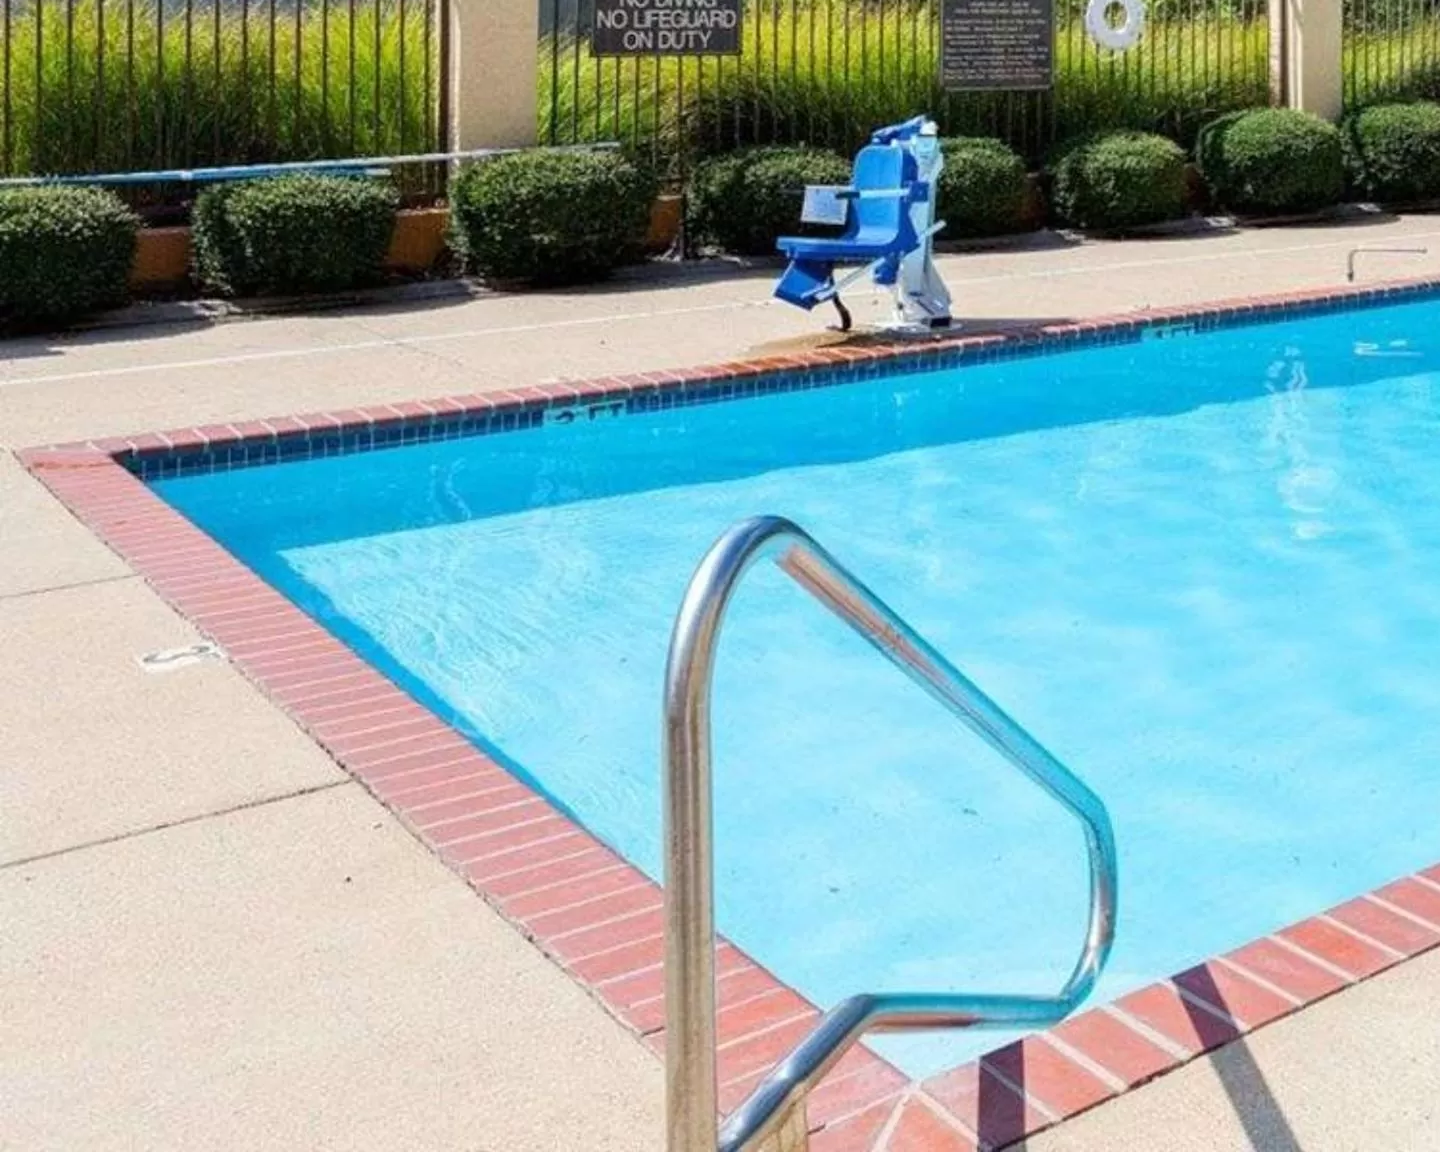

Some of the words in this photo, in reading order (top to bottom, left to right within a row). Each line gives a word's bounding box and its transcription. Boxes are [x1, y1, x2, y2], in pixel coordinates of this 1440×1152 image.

[596, 9, 628, 29] NO
[633, 9, 736, 29] LIFEGUARD
[623, 30, 653, 50] ON
[658, 30, 712, 49] DUTY
